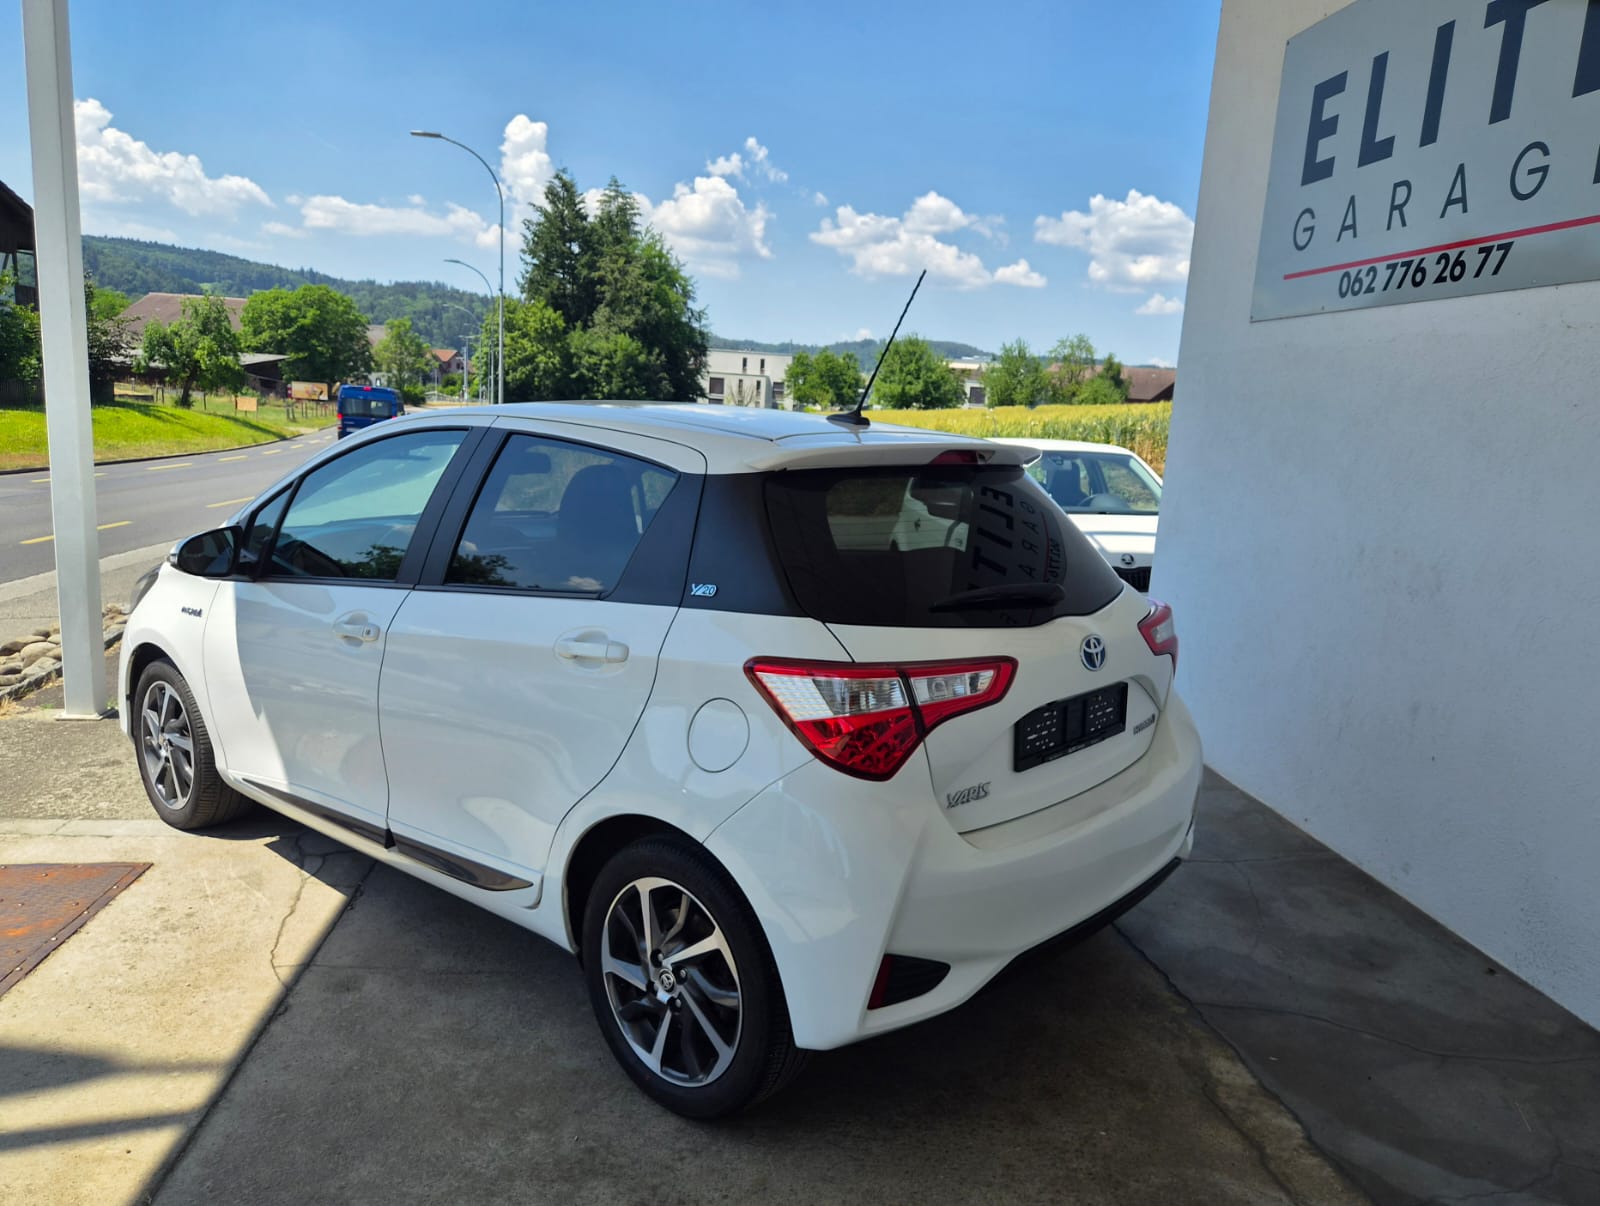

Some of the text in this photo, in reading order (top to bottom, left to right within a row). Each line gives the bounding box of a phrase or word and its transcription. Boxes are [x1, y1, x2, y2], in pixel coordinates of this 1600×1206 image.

[1292, 141, 1600, 252] GARAG
[1338, 241, 1514, 299] 062 776 26 77
[946, 781, 992, 809] YARIS
